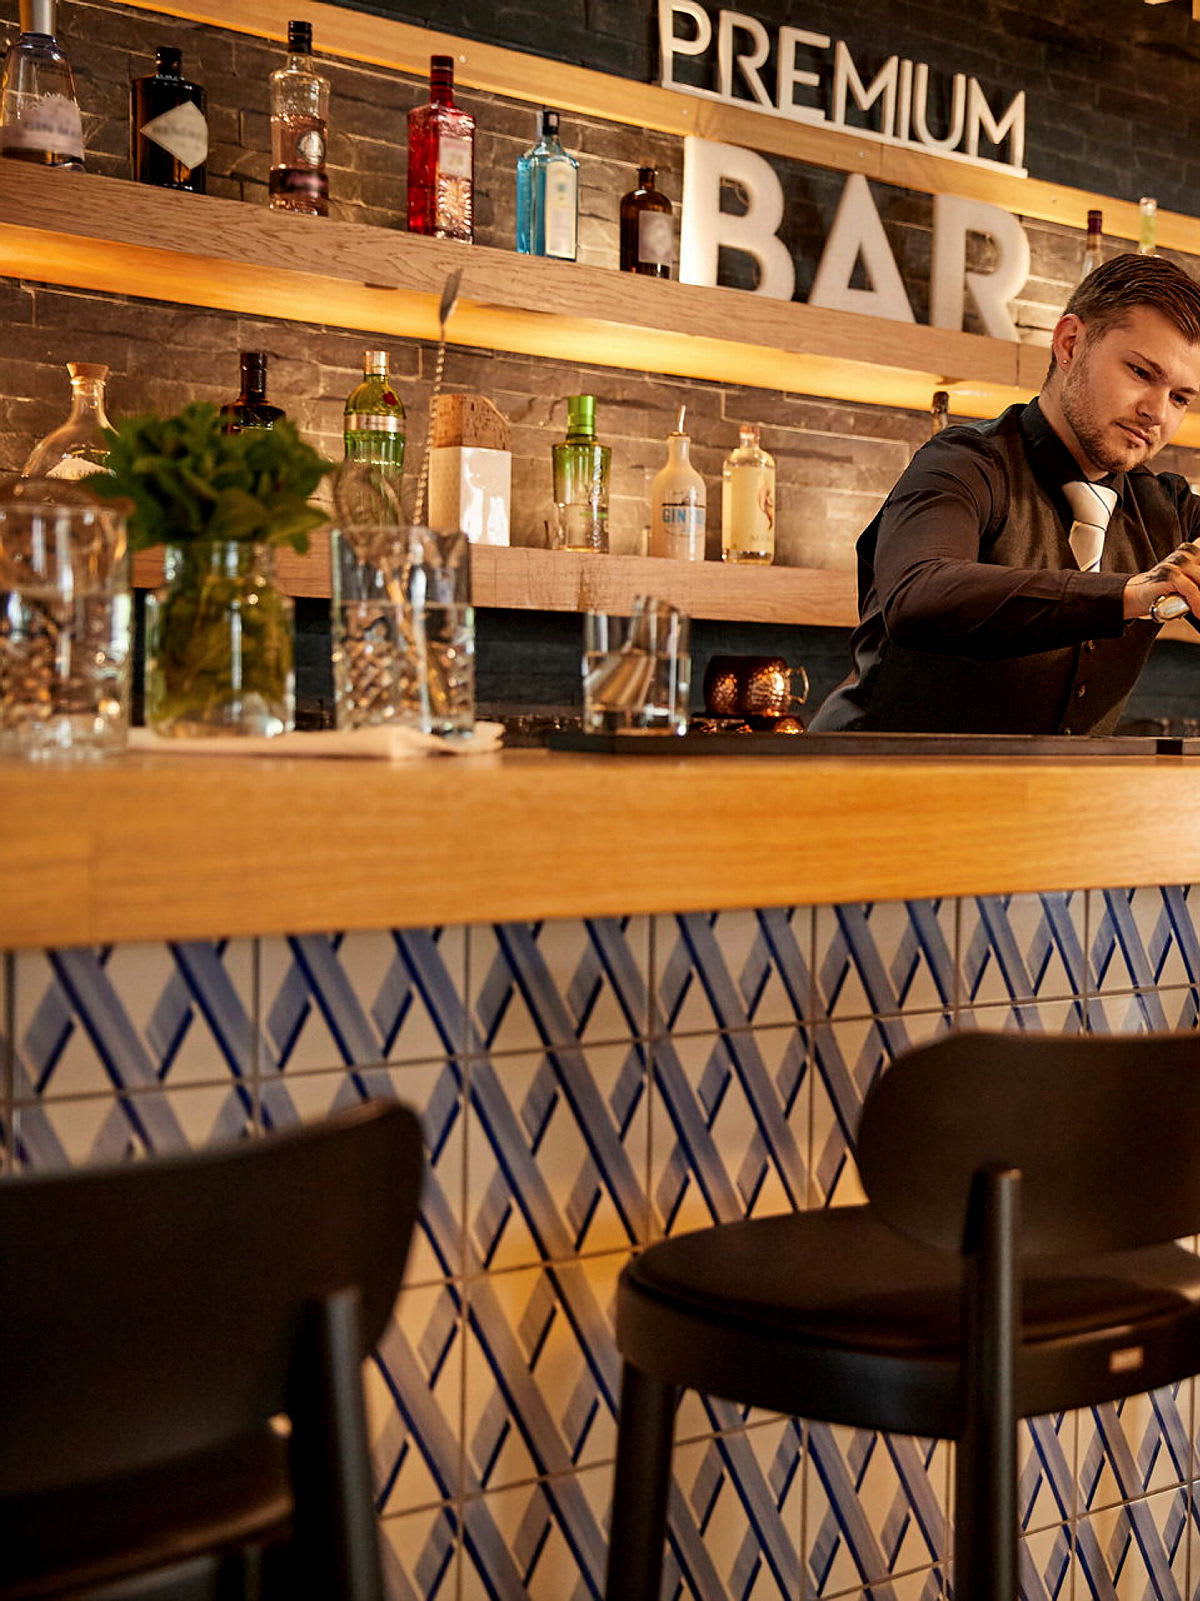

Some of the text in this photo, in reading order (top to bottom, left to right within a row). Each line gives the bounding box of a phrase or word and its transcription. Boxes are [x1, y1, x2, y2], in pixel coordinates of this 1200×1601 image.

[658, 0, 1027, 174] PREMIUM
[680, 137, 1030, 343] BAR
[662, 508, 686, 523] GIN
